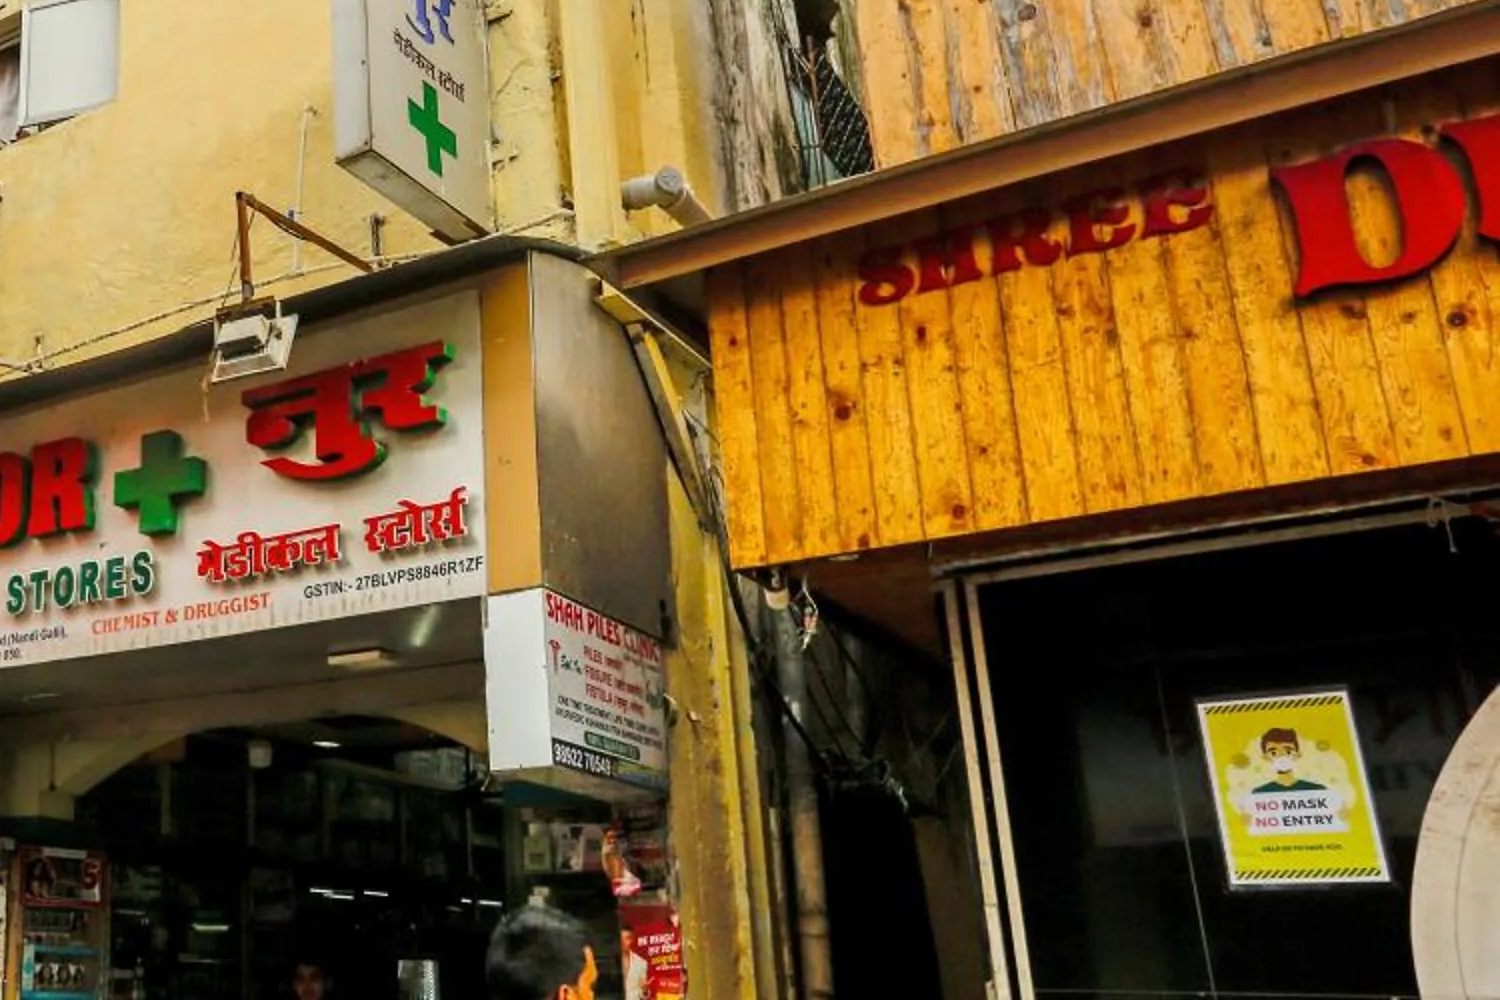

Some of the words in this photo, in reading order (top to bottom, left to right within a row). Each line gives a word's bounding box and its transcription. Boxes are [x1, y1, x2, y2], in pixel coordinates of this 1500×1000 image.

[196, 523, 340, 582] मेडीकल
[363, 486, 467, 552] स्टोर्स
[6, 551, 154, 615] STORES
[91, 611, 159, 635] CHEMIST
[165, 608, 179, 623] &
[183, 592, 270, 621] DRUGGIST
[545, 592, 584, 633] SHAH
[586, 611, 621, 647] PILES
[1255, 800, 1279, 811] NO
[1282, 798, 1328, 810] MASK
[1255, 817, 1279, 828] NO
[1282, 814, 1333, 827] ENTRY
